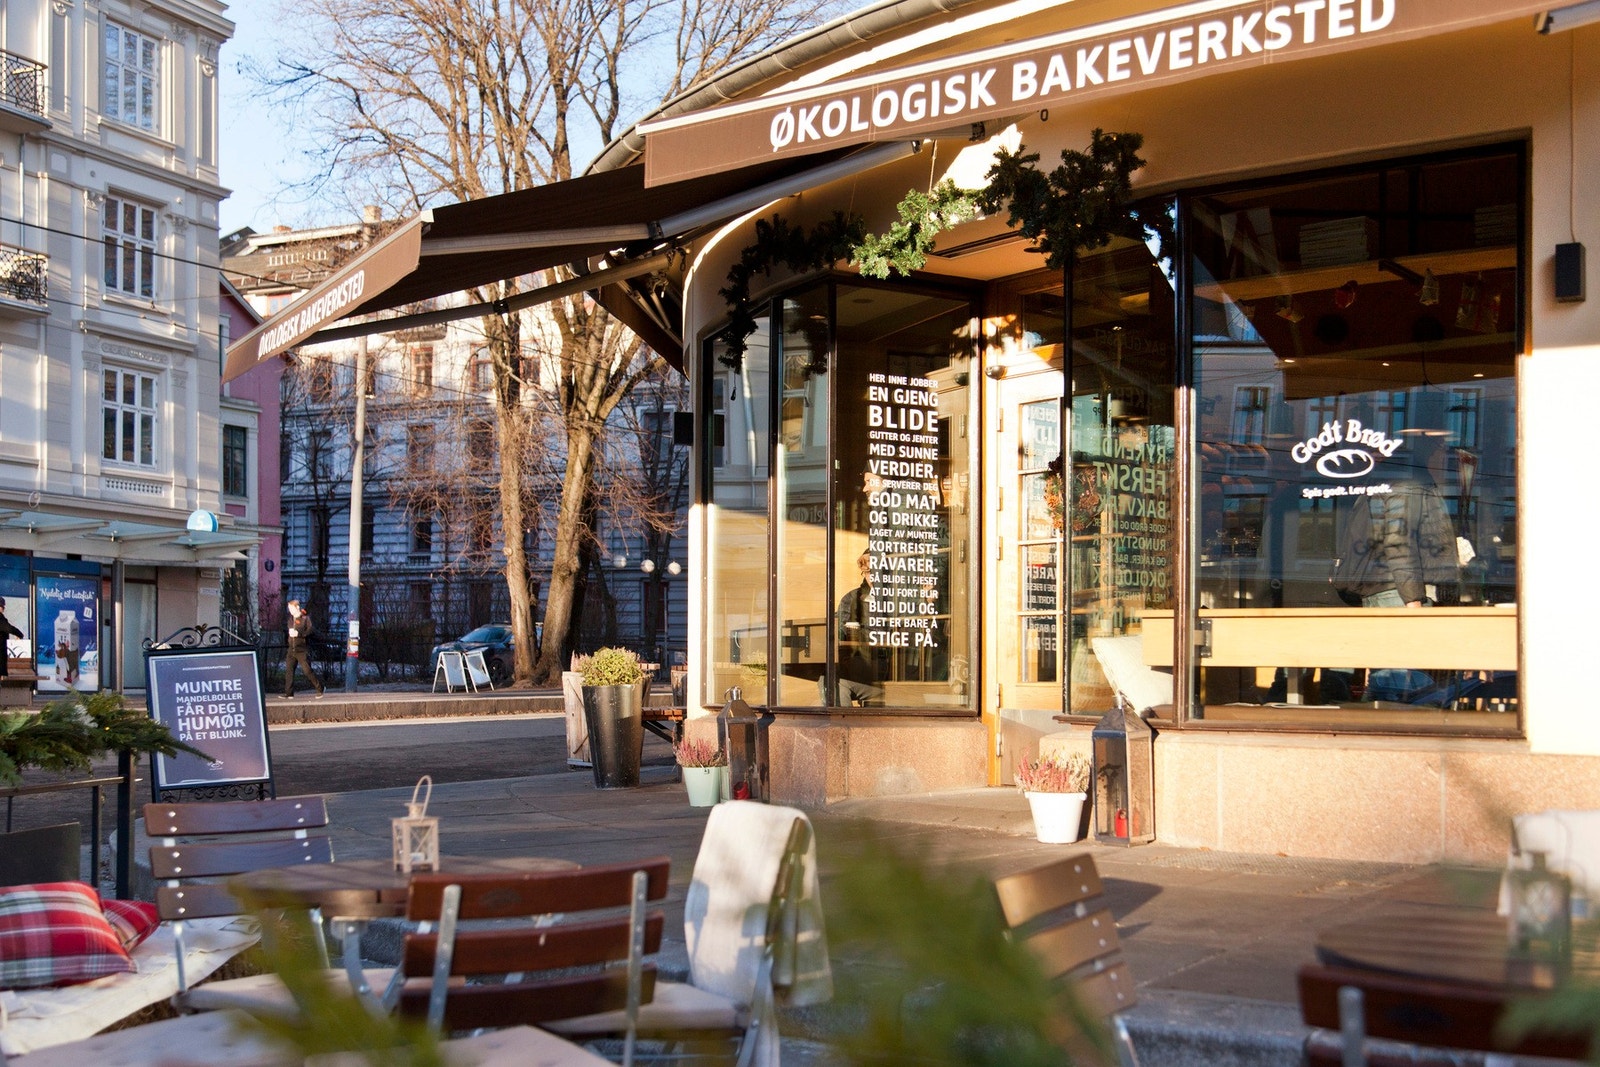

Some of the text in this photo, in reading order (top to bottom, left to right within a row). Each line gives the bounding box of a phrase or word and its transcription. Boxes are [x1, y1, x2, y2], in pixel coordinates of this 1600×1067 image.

[770, 0, 1395, 152] ØKOLOGISK BAKEVERKSTED
[258, 270, 365, 360] ØKOLOGISK BAKEVERKSTED
[870, 373, 938, 388] HER INNE JOBBER
[869, 386, 938, 407] EN GJENG
[869, 405, 938, 432] BLIDE
[870, 431, 938, 444] GUTTER OG JENTER
[1291, 419, 1404, 464] Godt Brød
[870, 444, 938, 460] MED SUNNE
[869, 460, 938, 479] VERDIER.
[870, 479, 938, 491] DE SERVERER DEG
[1302, 484, 1392, 499] Spis godt. Lev godt.
[869, 492, 938, 511] GOD MAT
[869, 511, 938, 527] OG DRIKKE
[870, 528, 938, 540] LAGET AV MUNTRE
[870, 540, 938, 555] KORTREISTE
[869, 553, 938, 572] RÅVARER.
[869, 572, 938, 586] SÅ BLIDE I FJESET
[869, 587, 938, 599] AT DU FORT BLIR
[869, 601, 938, 615] BLID DU OG.
[869, 616, 938, 629] DET ER BARE Å
[869, 629, 938, 648] STIGE PÅ.
[176, 679, 242, 694] MUNTRE
[176, 693, 242, 703] MANDELBOLLER
[177, 702, 244, 716] FÅR DEG I
[178, 714, 246, 731] HUMØR
[180, 731, 192, 741] PÅ
[210, 730, 246, 739] BLUNK.
